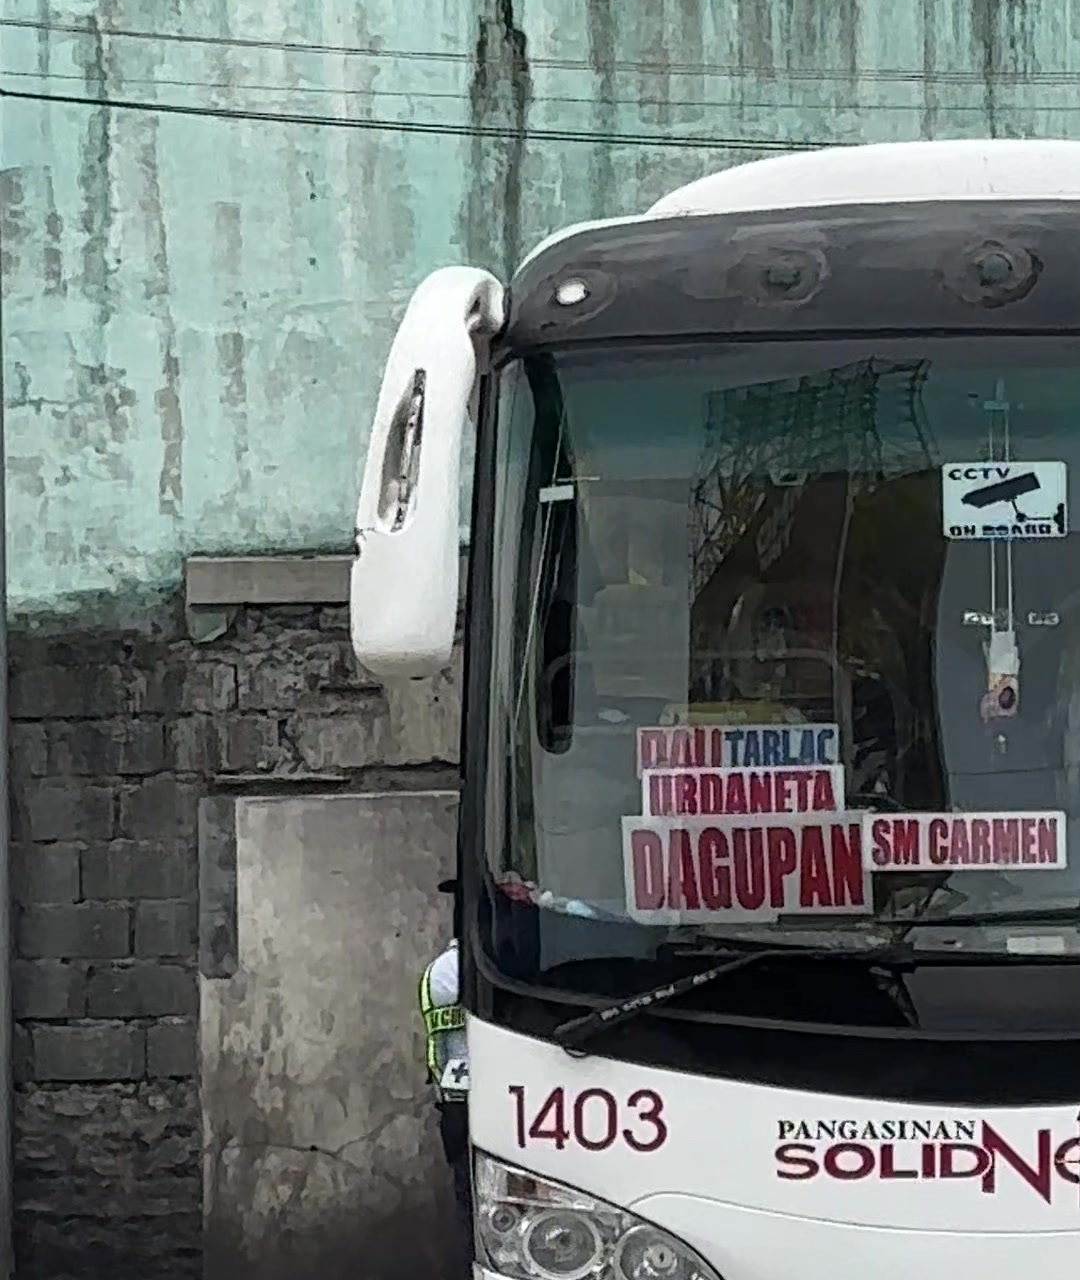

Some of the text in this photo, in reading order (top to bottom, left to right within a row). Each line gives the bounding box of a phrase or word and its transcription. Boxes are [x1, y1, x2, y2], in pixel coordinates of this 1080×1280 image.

[948, 468, 1010, 481] CCTV
[725, 727, 835, 767] TARLAC
[648, 769, 837, 816] URDANETA
[871, 816, 1059, 866] SM CARMEN
[631, 823, 866, 911] DAGUPAN
[508, 1085, 668, 1152] 1403
[777, 1120, 976, 1141] PANGASINAN
